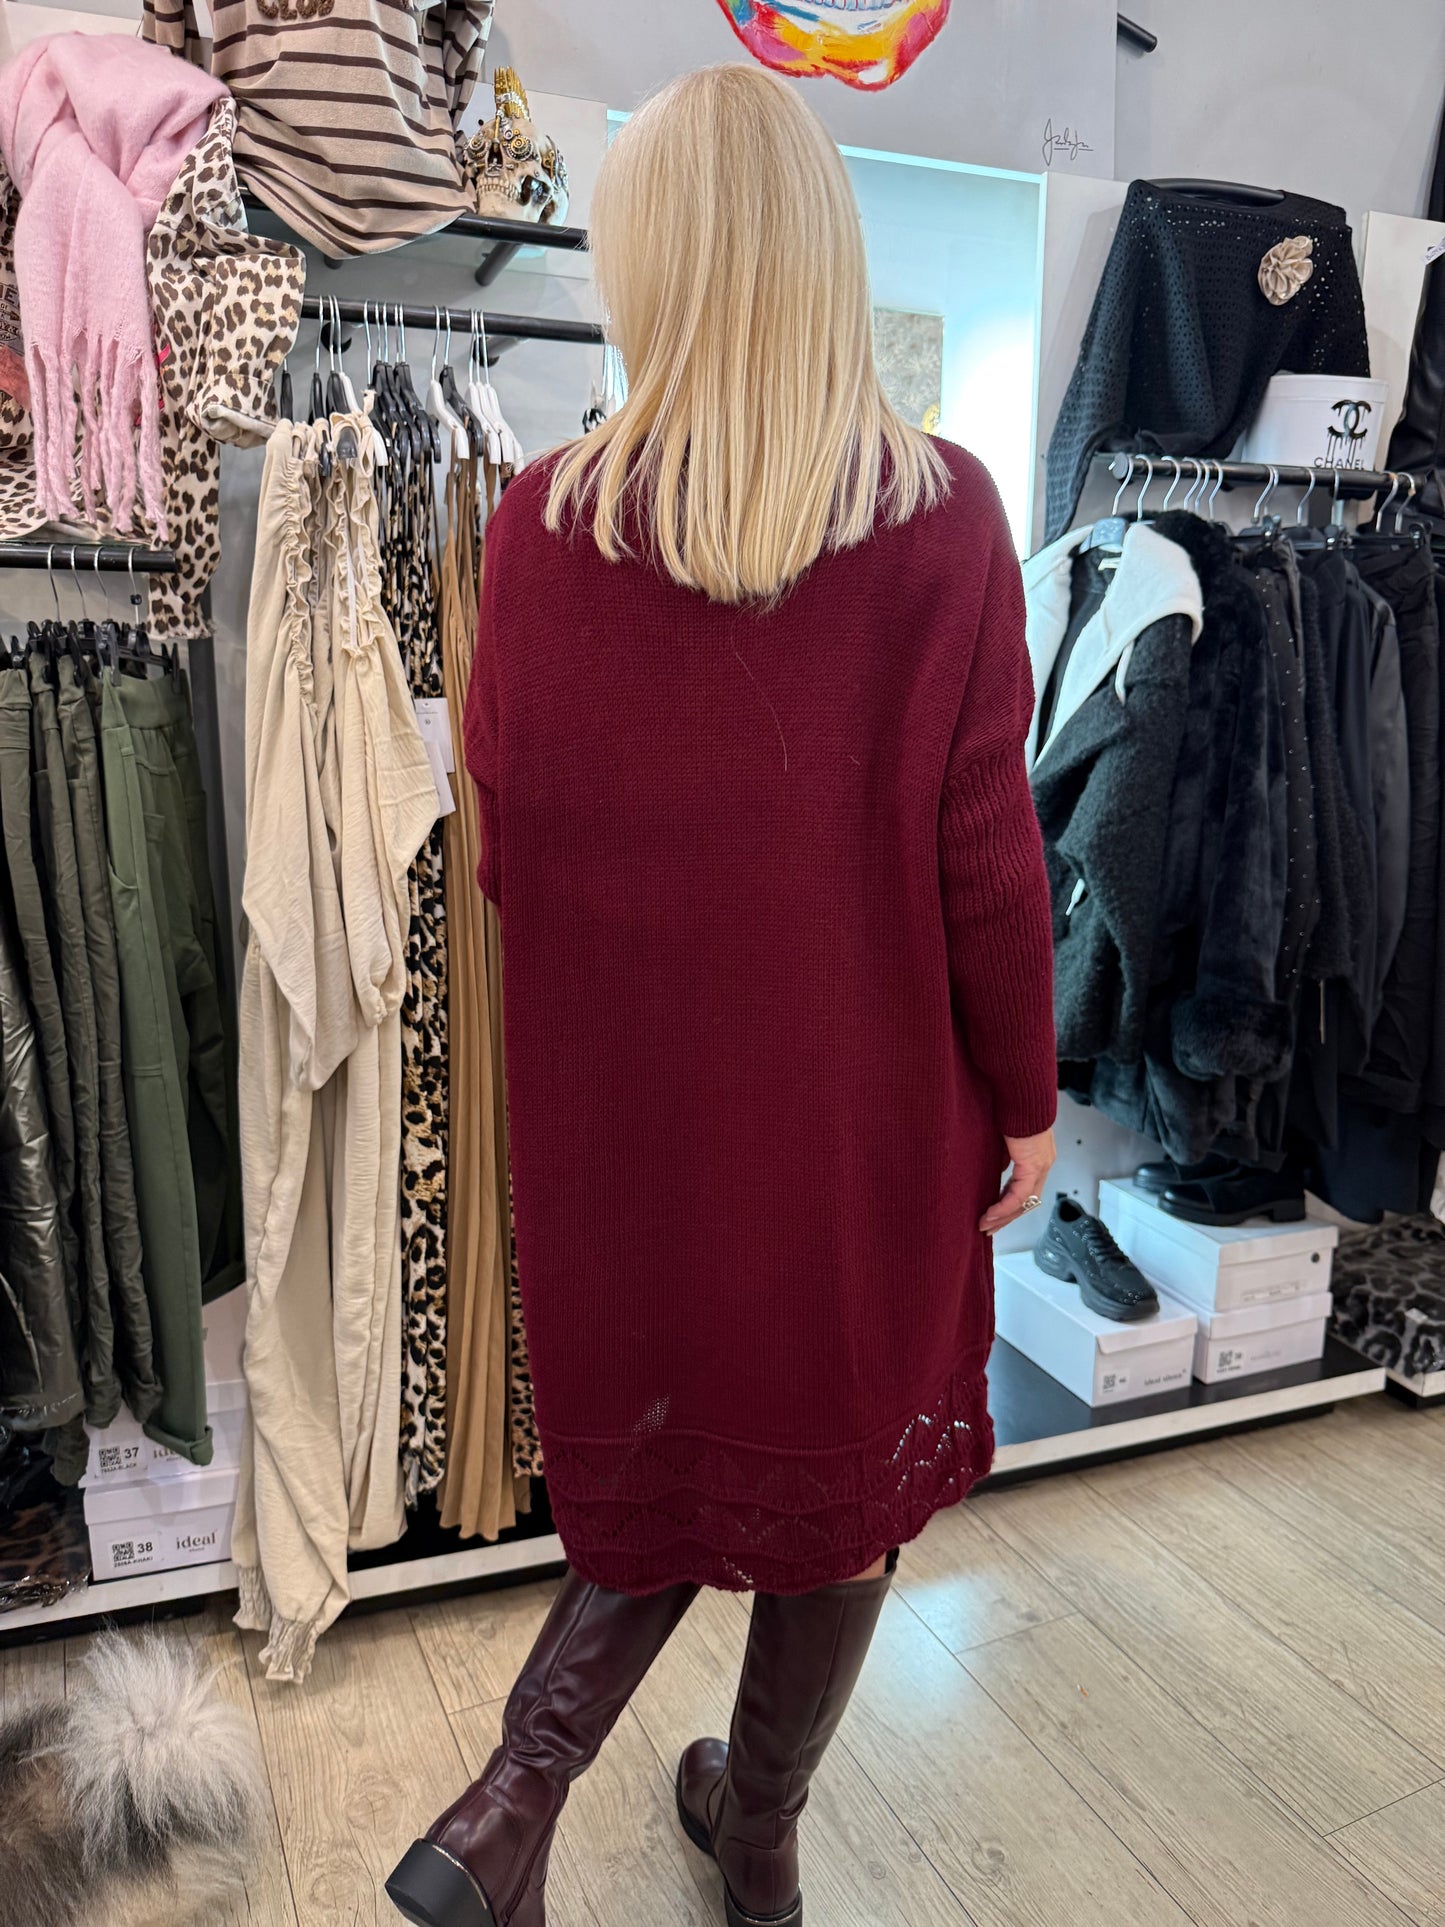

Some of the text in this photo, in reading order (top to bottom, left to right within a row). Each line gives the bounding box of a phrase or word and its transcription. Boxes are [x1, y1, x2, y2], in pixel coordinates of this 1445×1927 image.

[1313, 456, 1365, 471] CHANEL
[123, 1446, 140, 1459] 37
[137, 1541, 154, 1553] 38
[176, 1532, 216, 1550] ideal
